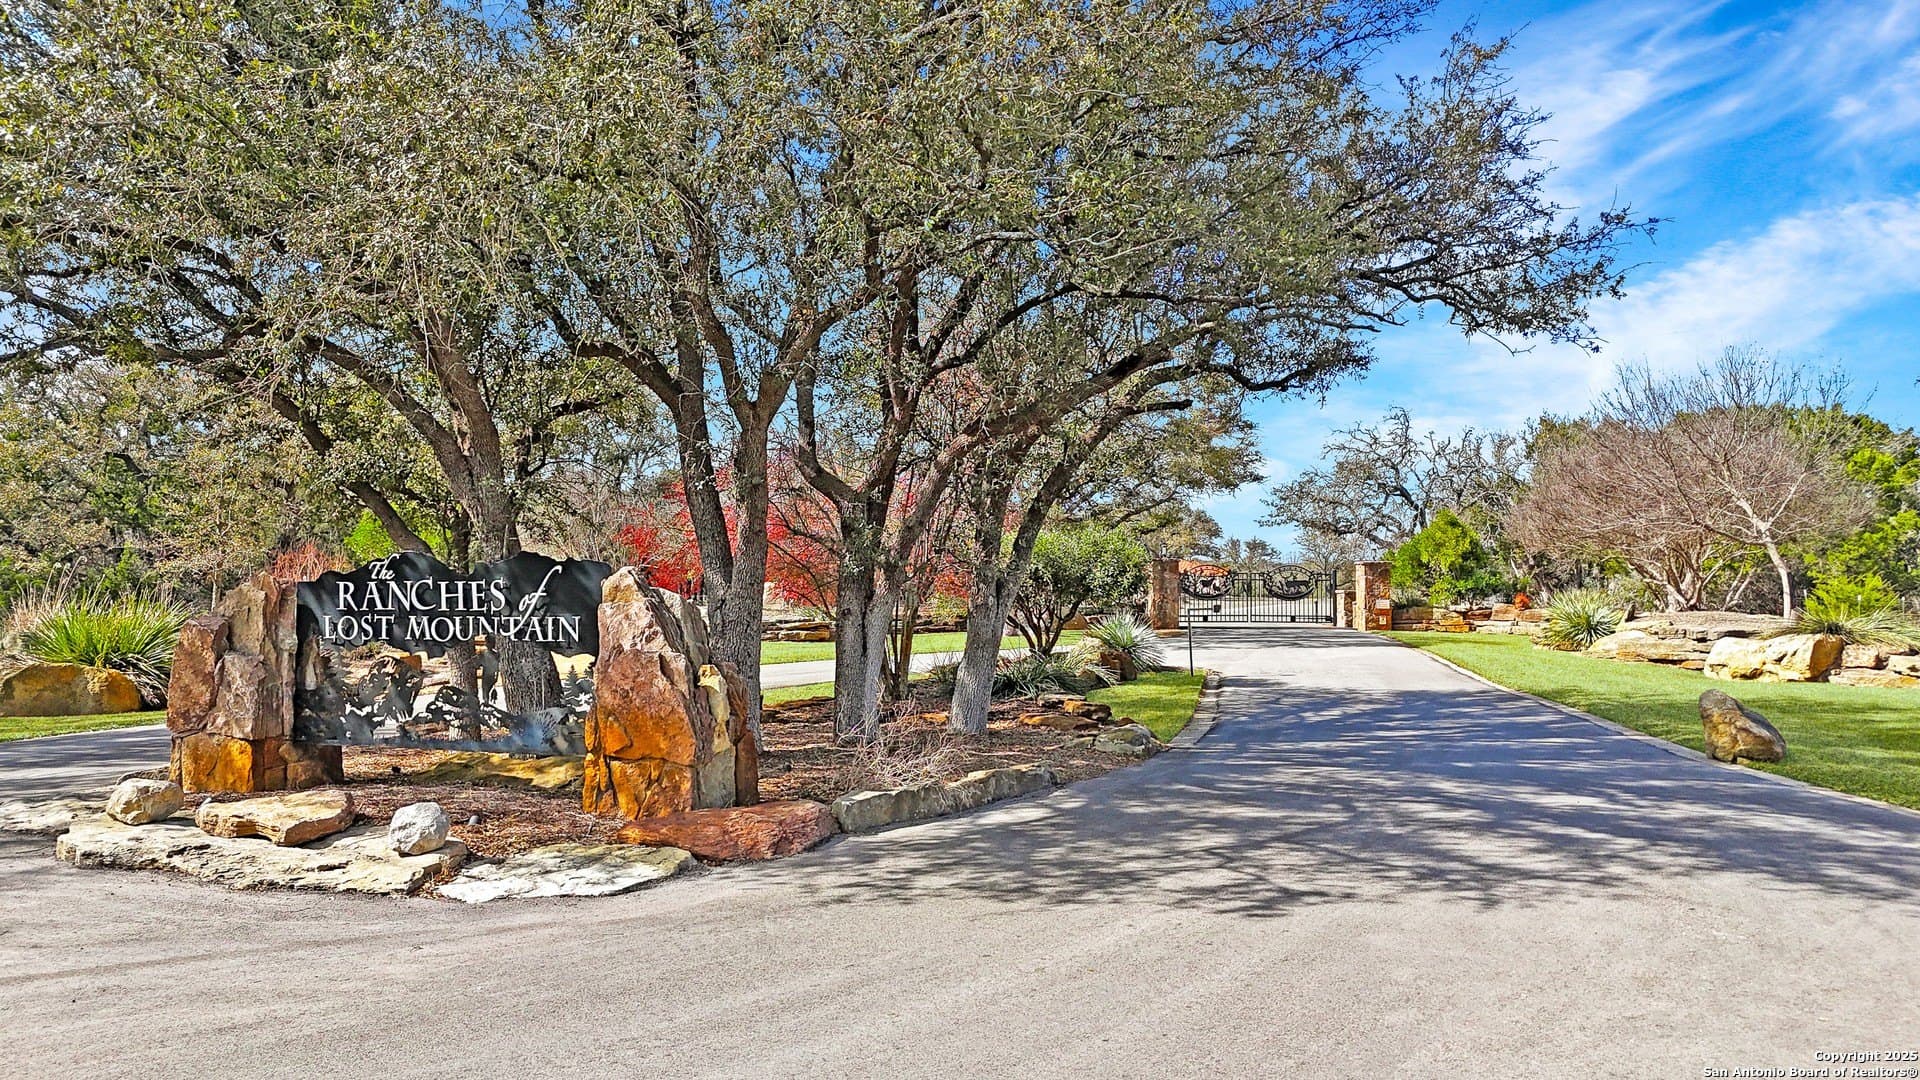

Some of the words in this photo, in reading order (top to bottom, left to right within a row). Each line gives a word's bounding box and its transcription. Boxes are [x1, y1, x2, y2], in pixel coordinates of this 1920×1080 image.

[369, 553, 399, 579] The
[336, 576, 506, 612] RANCHES
[502, 565, 562, 635] of
[323, 615, 395, 641] LOST
[405, 614, 581, 642] MOUNTAIN
